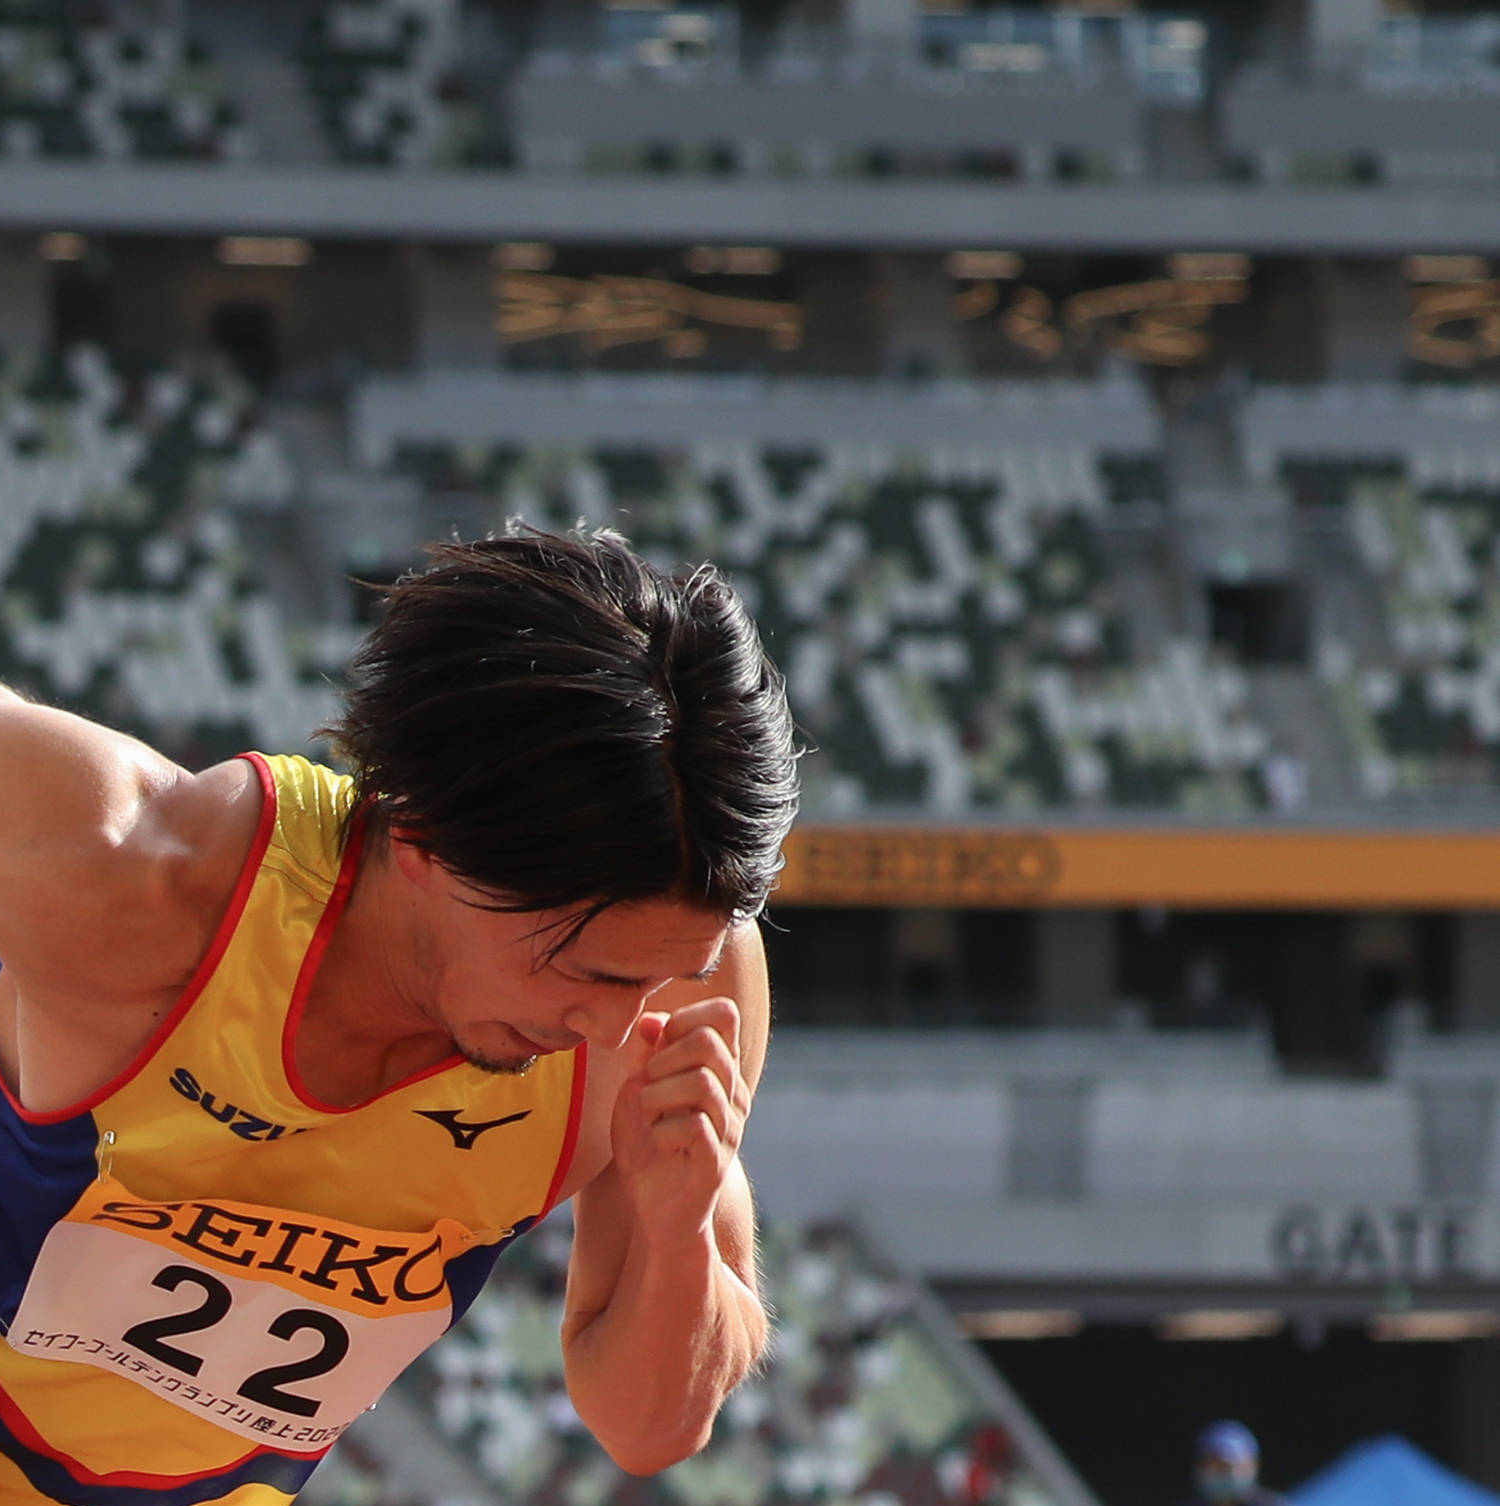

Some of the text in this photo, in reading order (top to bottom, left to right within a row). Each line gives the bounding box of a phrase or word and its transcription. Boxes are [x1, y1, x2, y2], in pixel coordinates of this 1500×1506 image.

[91, 1201, 448, 1306] SEIKO
[1265, 1203, 1482, 1280] GATE
[22, 1328, 350, 1443] セイコーゴールデングランプリ陸上202
[121, 1264, 350, 1418] 22
